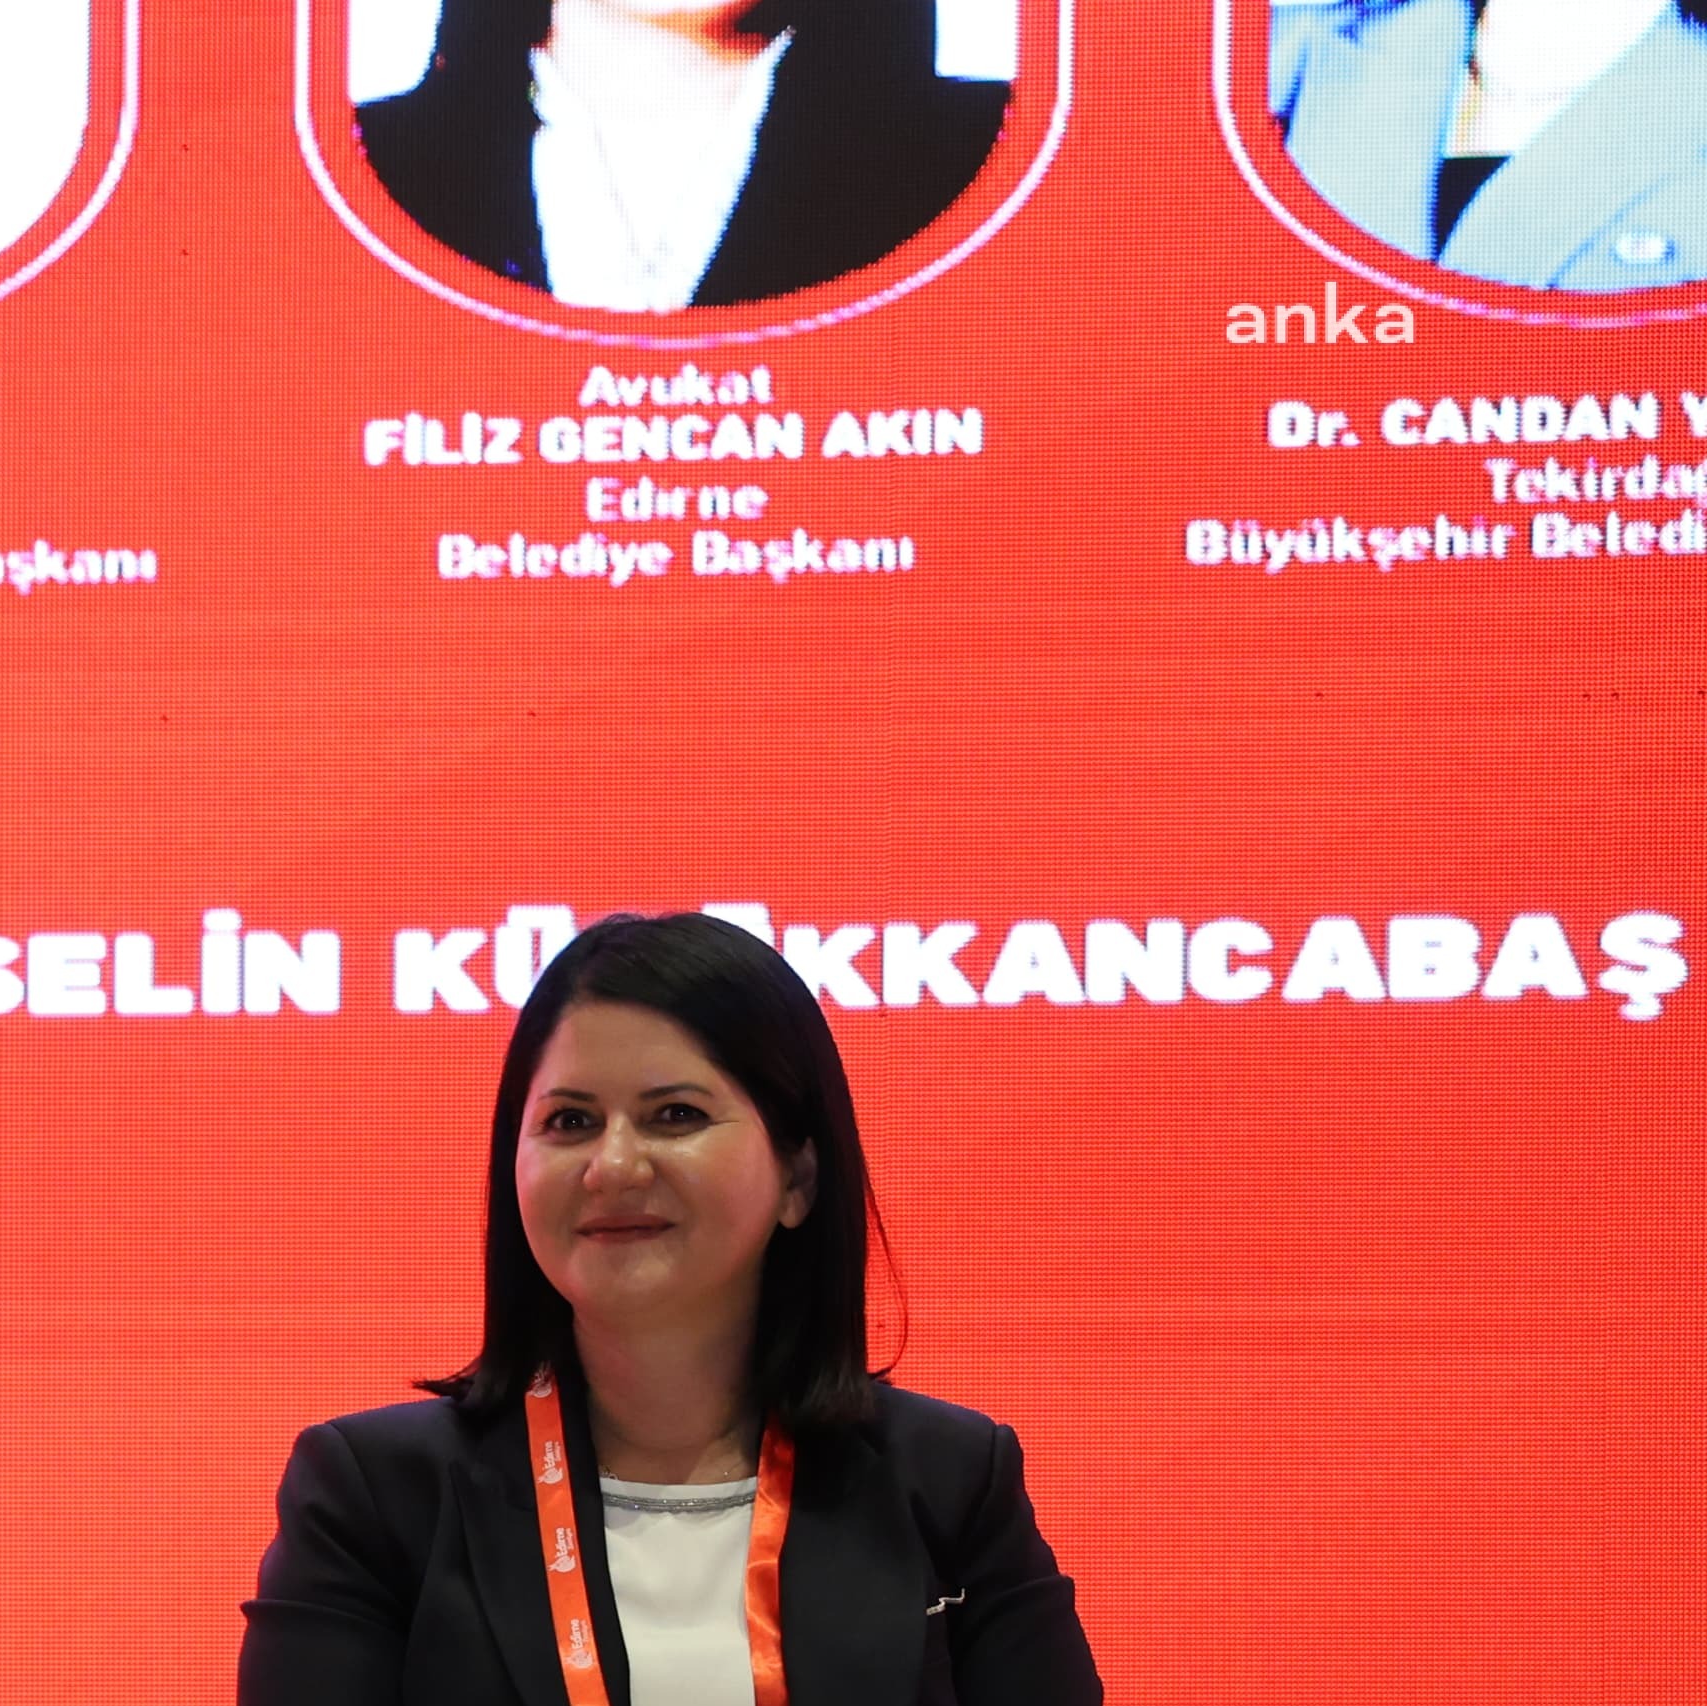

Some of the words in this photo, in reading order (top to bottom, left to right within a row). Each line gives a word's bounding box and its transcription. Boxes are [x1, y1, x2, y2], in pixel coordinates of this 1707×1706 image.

[576, 361, 775, 409] Avukat
[362, 409, 524, 467] FİLİZ
[537, 405, 806, 465] GENCAN
[820, 406, 985, 459] AKIN
[1267, 400, 1361, 449] Dr.
[1380, 391, 1661, 447] CANDAN
[436, 531, 675, 588] Belediye
[691, 527, 916, 585] Başkanı
[1185, 513, 1517, 575] Büyükşehir
[390, 902, 1693, 1024] KÜKKANCABAŞ
[570, 1618, 584, 1650] Edirne
